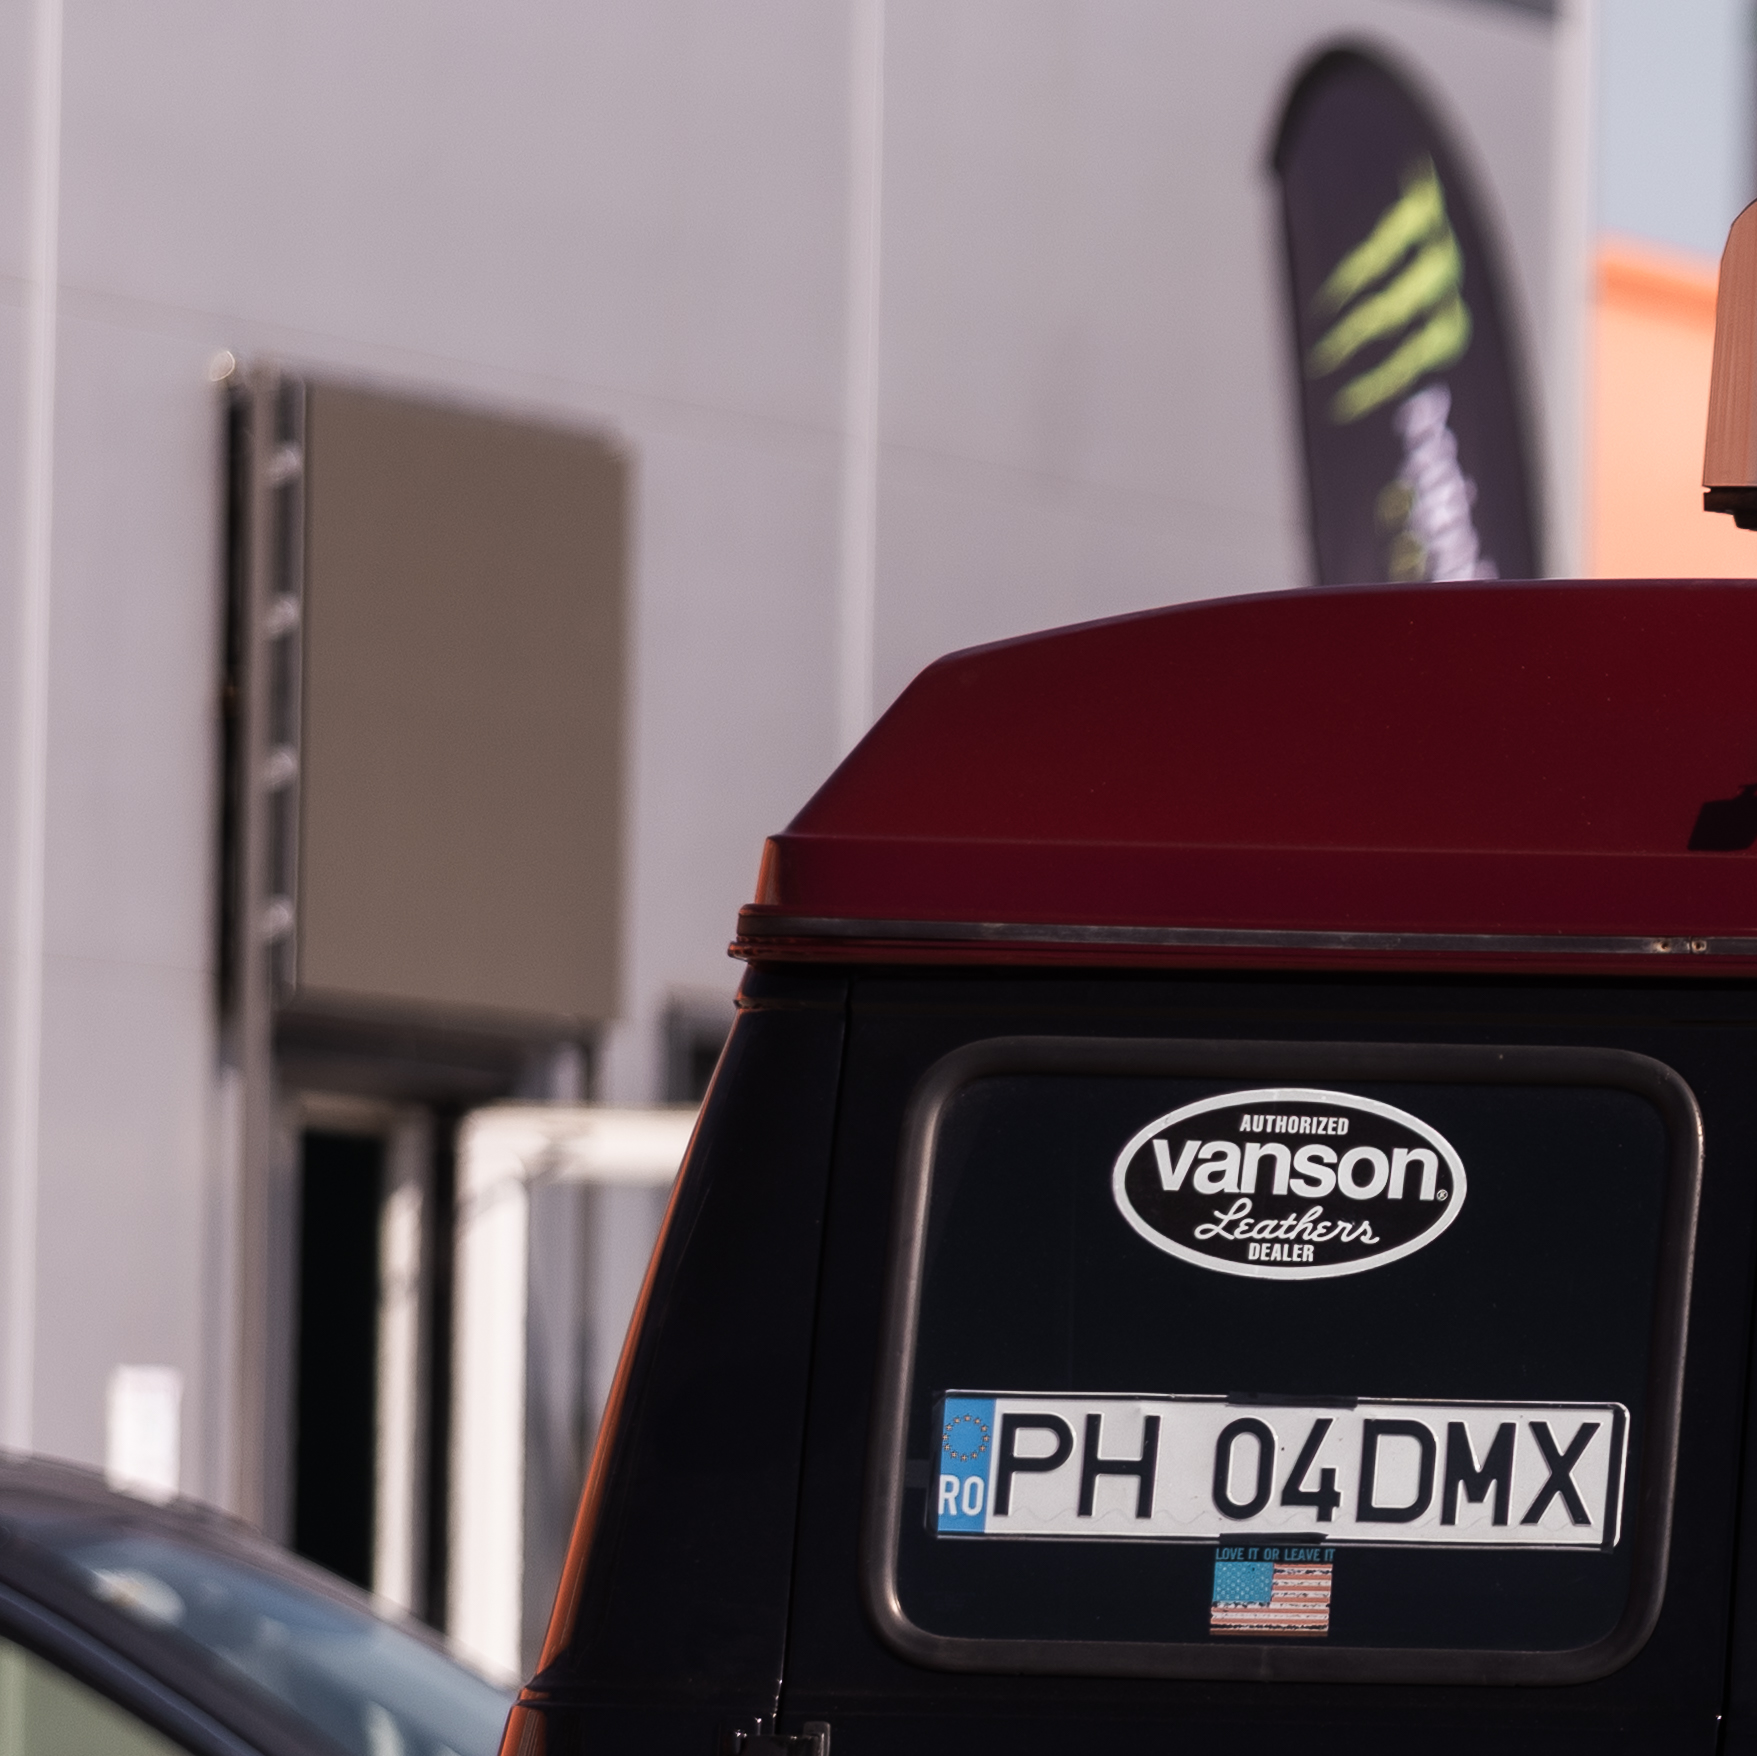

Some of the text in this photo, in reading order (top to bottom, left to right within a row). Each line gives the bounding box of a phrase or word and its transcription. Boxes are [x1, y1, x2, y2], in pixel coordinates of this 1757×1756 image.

[1239, 1113, 1350, 1136] AUTHORIZED
[1152, 1137, 1440, 1201] vanson
[1193, 1197, 1381, 1245] Leathers
[1247, 1243, 1315, 1263] DEALER
[992, 1412, 1161, 1520] PH
[937, 1474, 985, 1517] RO
[1215, 1547, 1336, 1562] LOVE IT OR LEAVE IT
